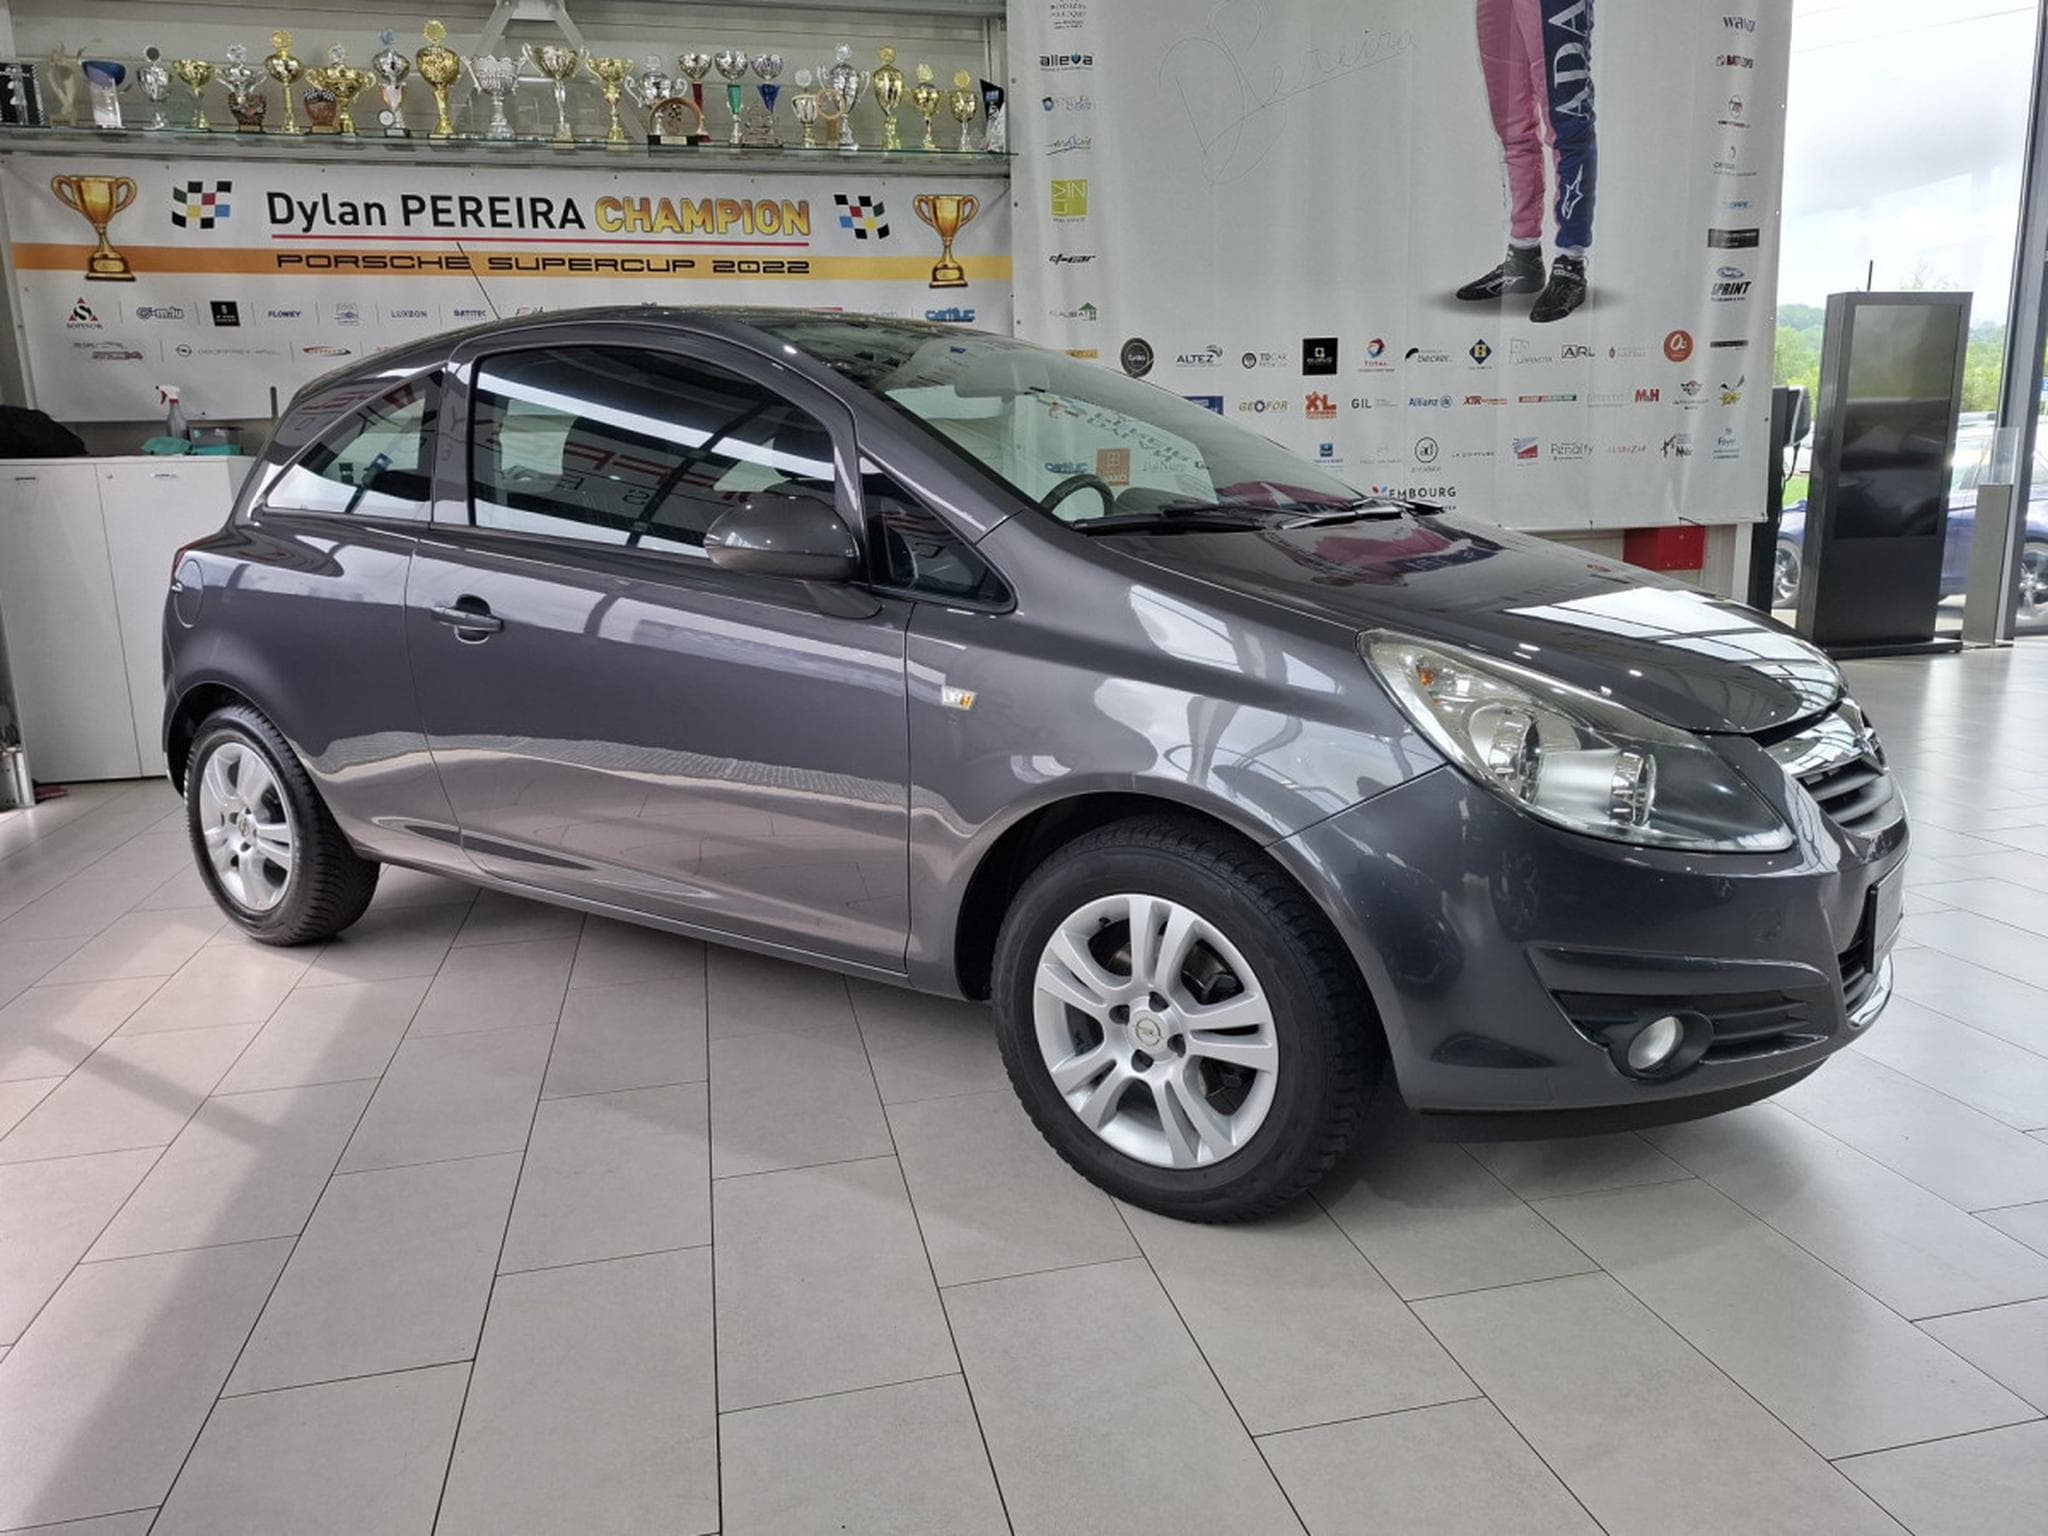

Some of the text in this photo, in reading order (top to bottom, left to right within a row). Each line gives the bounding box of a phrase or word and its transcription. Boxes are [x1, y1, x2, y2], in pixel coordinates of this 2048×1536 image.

[1039, 54, 1093, 67] alleva
[266, 191, 811, 236] Dylan PEREIRA CHAMPION
[276, 254, 810, 274] PORSCHE SUPERCUP 2022
[1176, 354, 1214, 364] ALTEZ
[1351, 399, 1372, 409] GIL
[1409, 397, 1438, 407] Allianz
